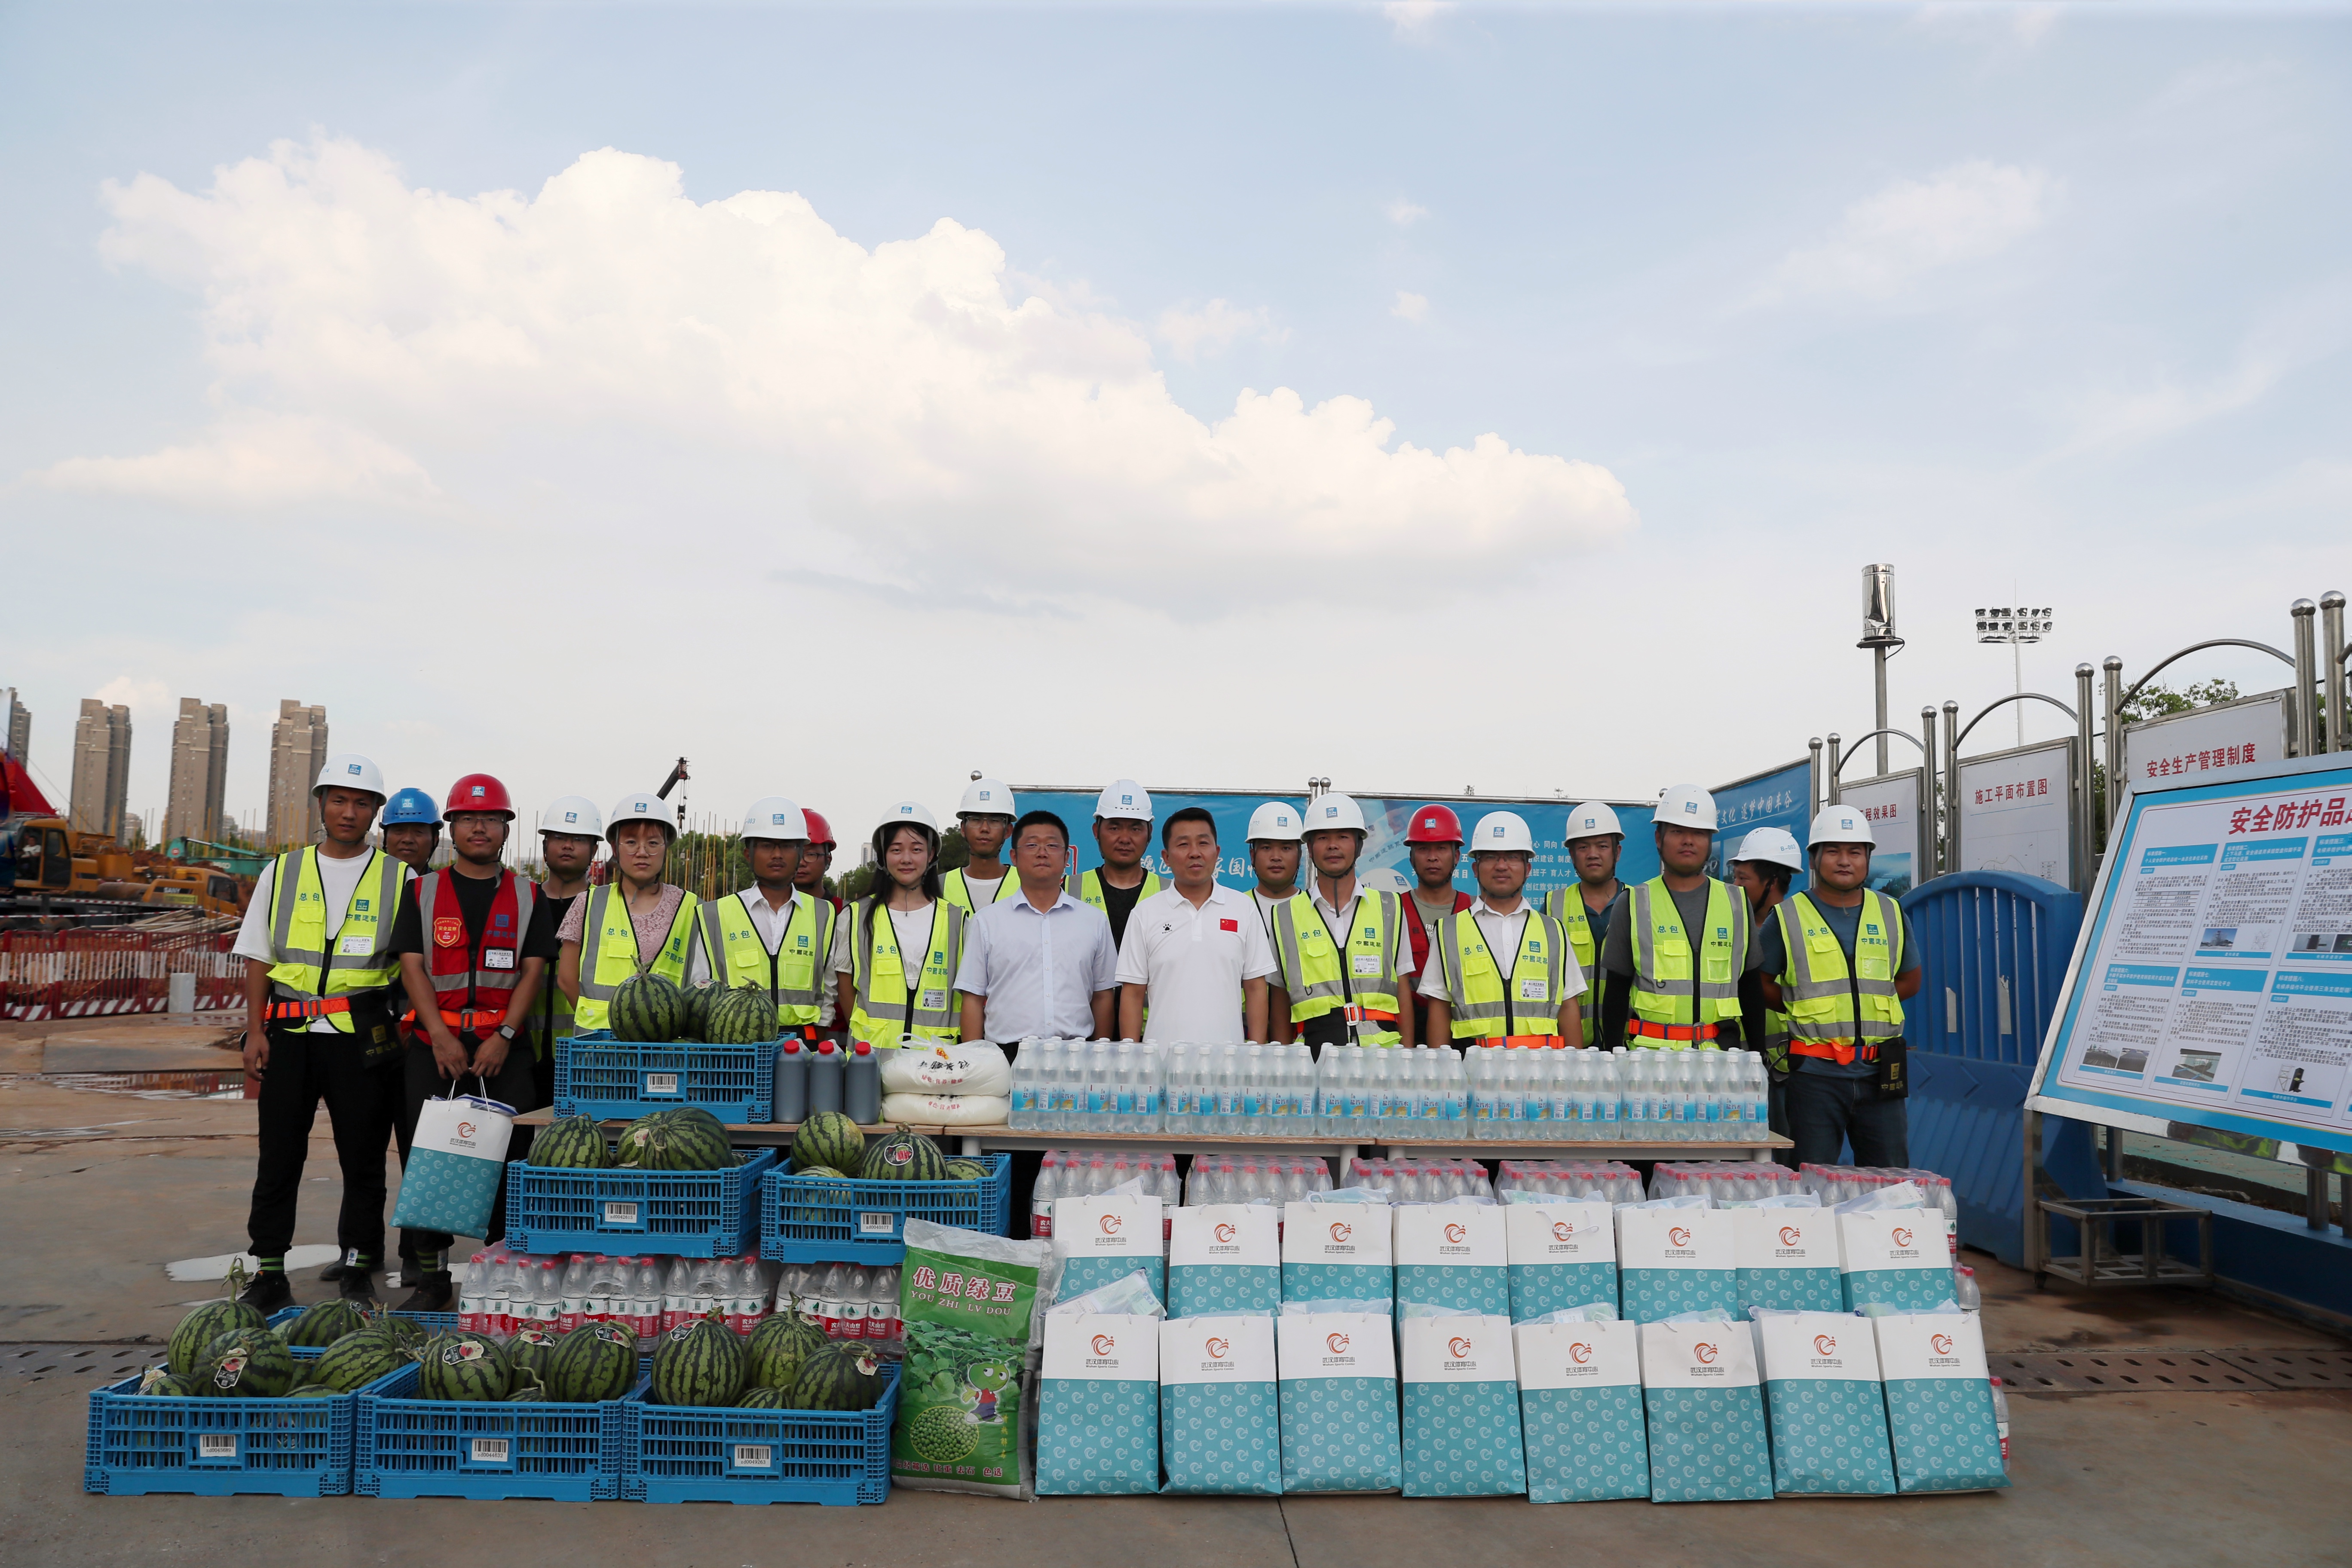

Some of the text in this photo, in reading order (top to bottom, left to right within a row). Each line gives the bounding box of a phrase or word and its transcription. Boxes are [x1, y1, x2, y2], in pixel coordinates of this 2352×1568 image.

[2147, 743, 2255, 778] 安全生产管理制度
[1975, 778, 2047, 805] 施工平面布置图
[1544, 841, 1557, 849] 同向
[1551, 869, 1571, 877] 育人才
[299, 893, 319, 901] 总包
[347, 914, 377, 922] 中國建築
[1568, 915, 1585, 923] 总包
[607, 928, 628, 937] 总包
[730, 930, 750, 941] 总包
[1301, 929, 1322, 939] 总包
[1807, 927, 1828, 937] 总包
[877, 945, 897, 954] 总包
[1464, 944, 1484, 955] 总包
[1522, 955, 1548, 965] 中國建築
[913, 1265, 1016, 1302] 优质绿豆
[911, 1290, 1011, 1315] YOU ZHI LV DOU
[933, 1464, 952, 1473] 比重
[956, 1466, 975, 1475] 去石
[983, 1467, 1003, 1477] 色选
